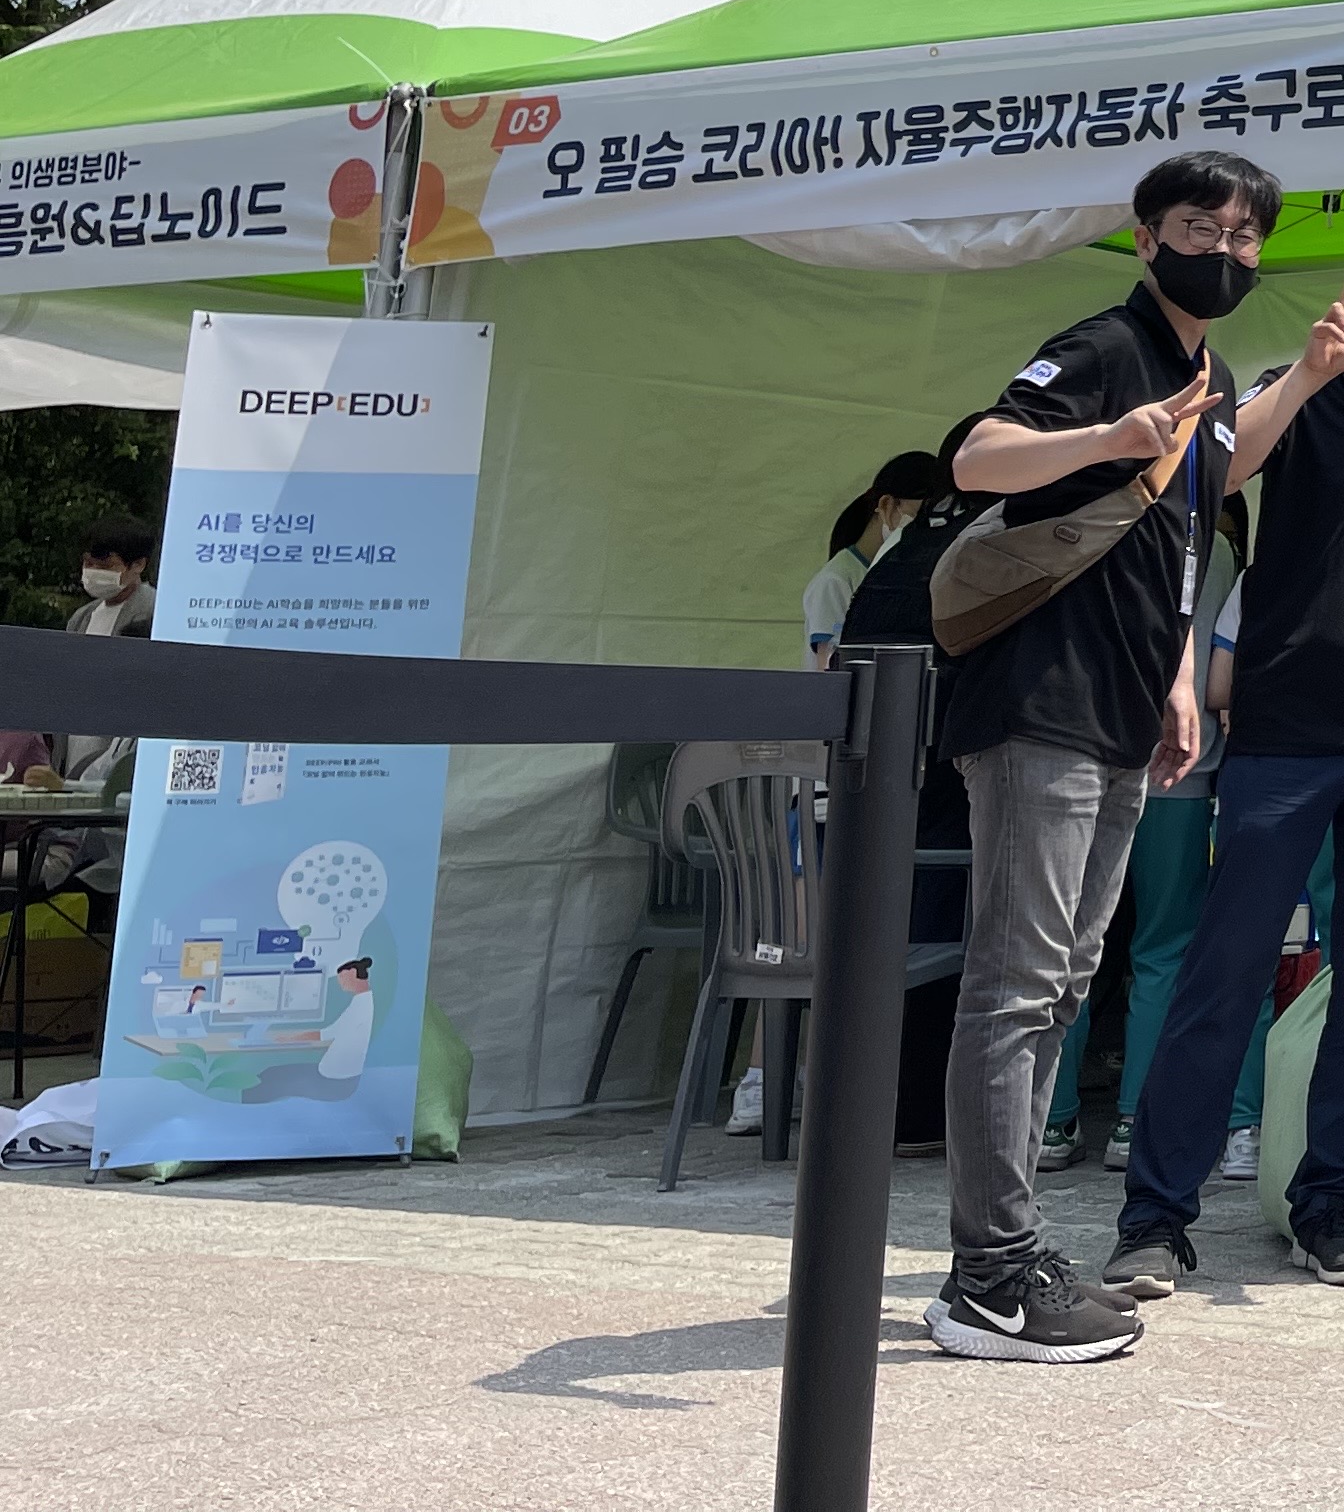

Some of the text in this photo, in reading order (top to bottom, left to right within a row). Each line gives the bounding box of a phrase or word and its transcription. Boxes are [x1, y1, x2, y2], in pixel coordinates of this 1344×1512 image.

[508, 104, 551, 136] 03
[542, 140, 585, 199] 오
[594, 130, 685, 194] 필승
[691, 115, 843, 183] 코리아!
[856, 81, 1184, 168] 자율주행자동차
[197, 512, 315, 535] AI를 당신의
[195, 542, 397, 566] 경쟁력으로 만드세요
[260, 618, 274, 630] AI
